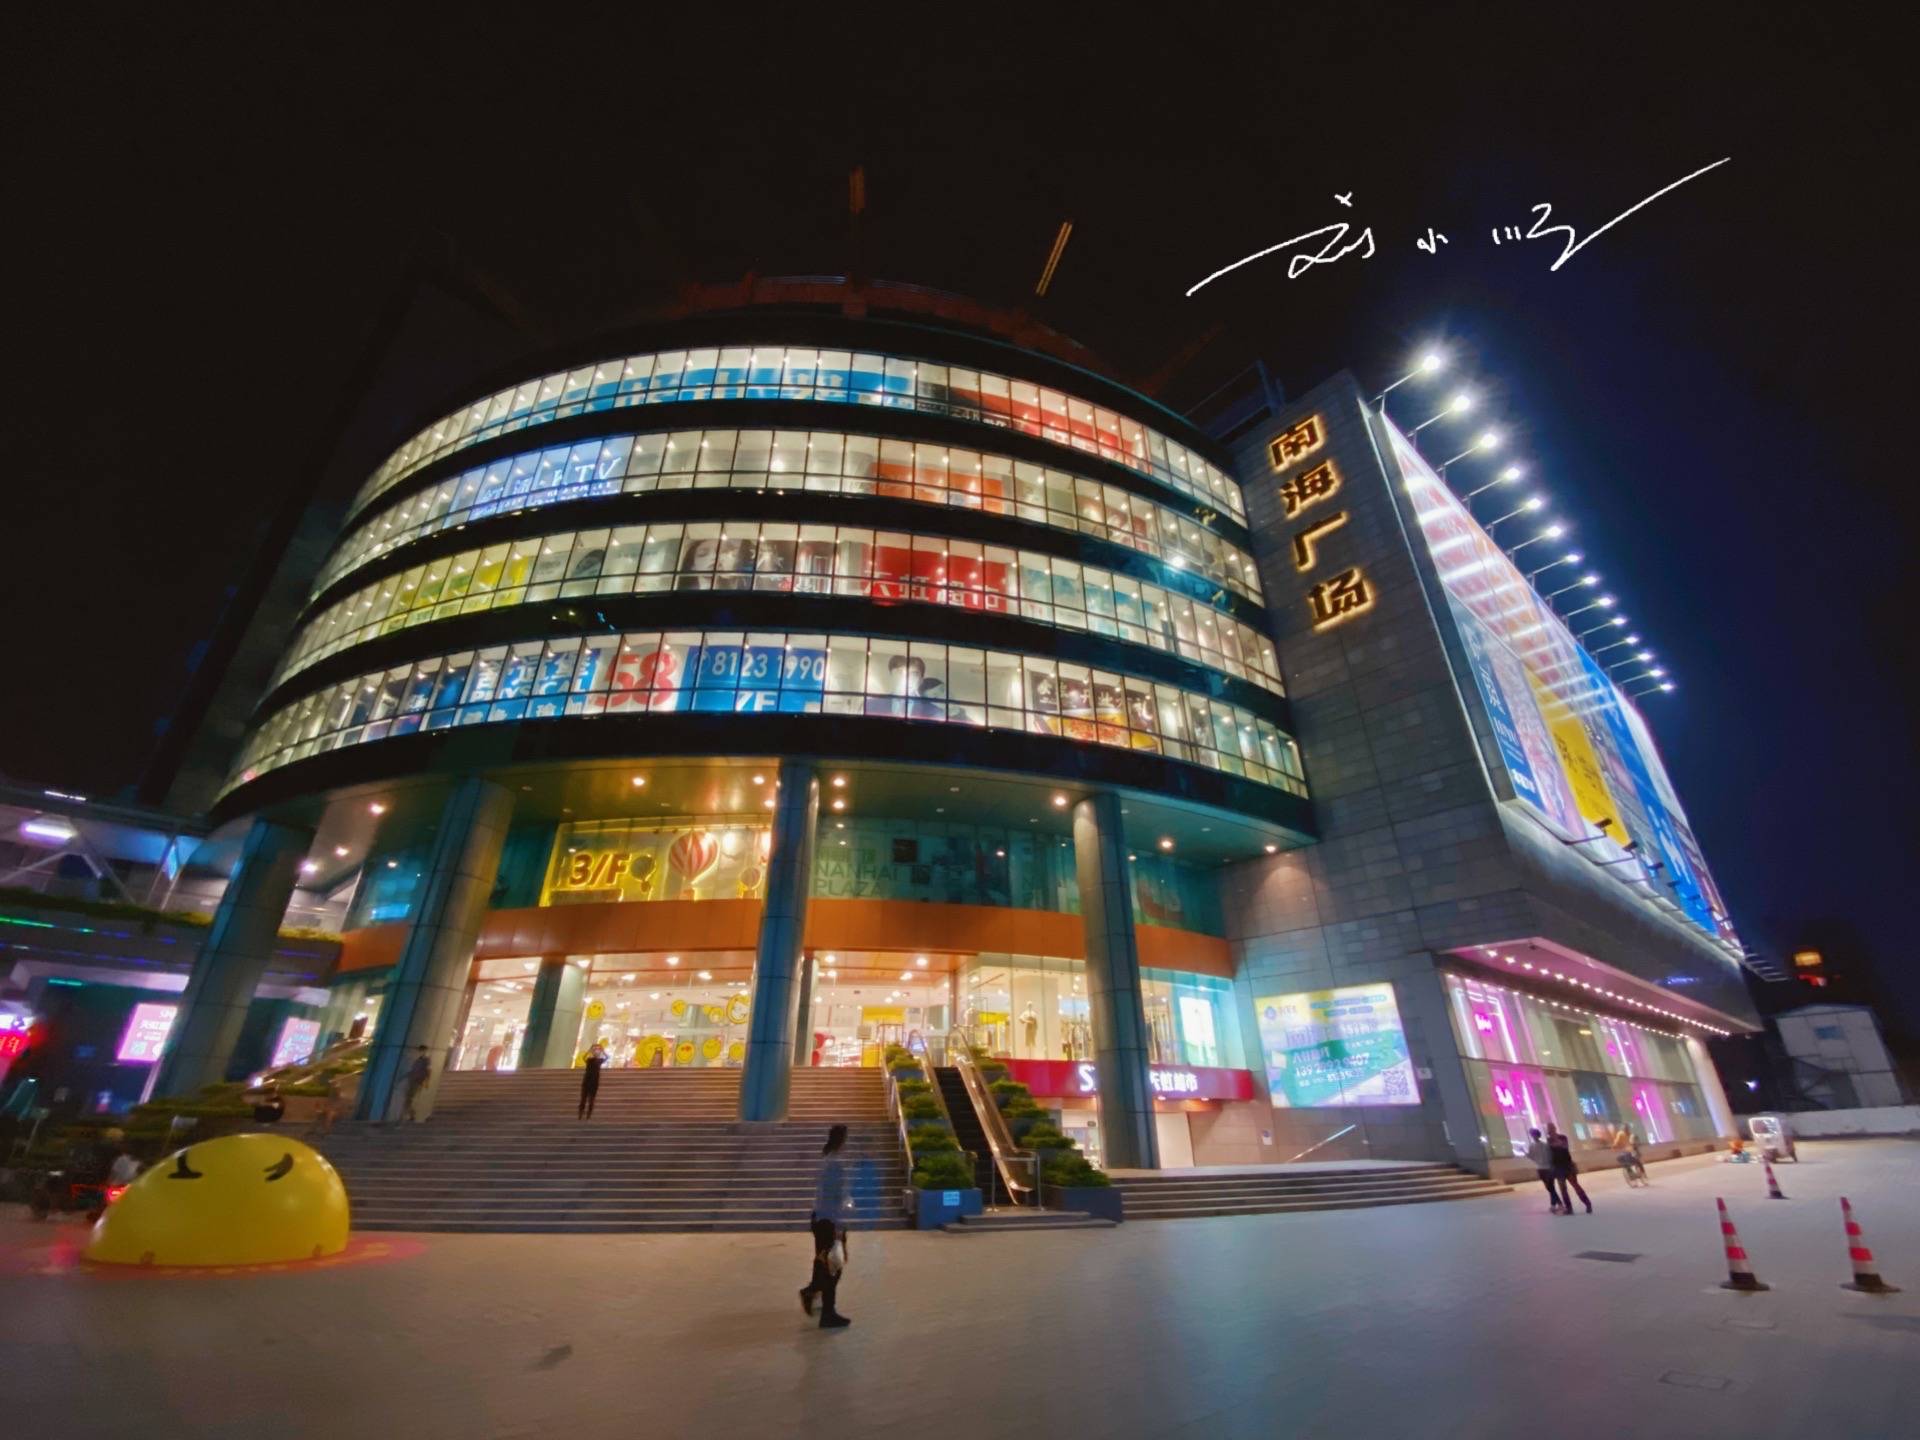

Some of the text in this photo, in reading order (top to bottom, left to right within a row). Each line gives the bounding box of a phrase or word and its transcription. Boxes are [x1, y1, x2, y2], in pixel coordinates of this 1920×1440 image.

[1267, 412, 1375, 634] 南海广场
[593, 651, 678, 708] 58
[712, 651, 825, 683] 8123 1990
[569, 853, 632, 885] 3/F
[814, 862, 898, 880] NANHAI
[813, 879, 881, 897] PLAZA
